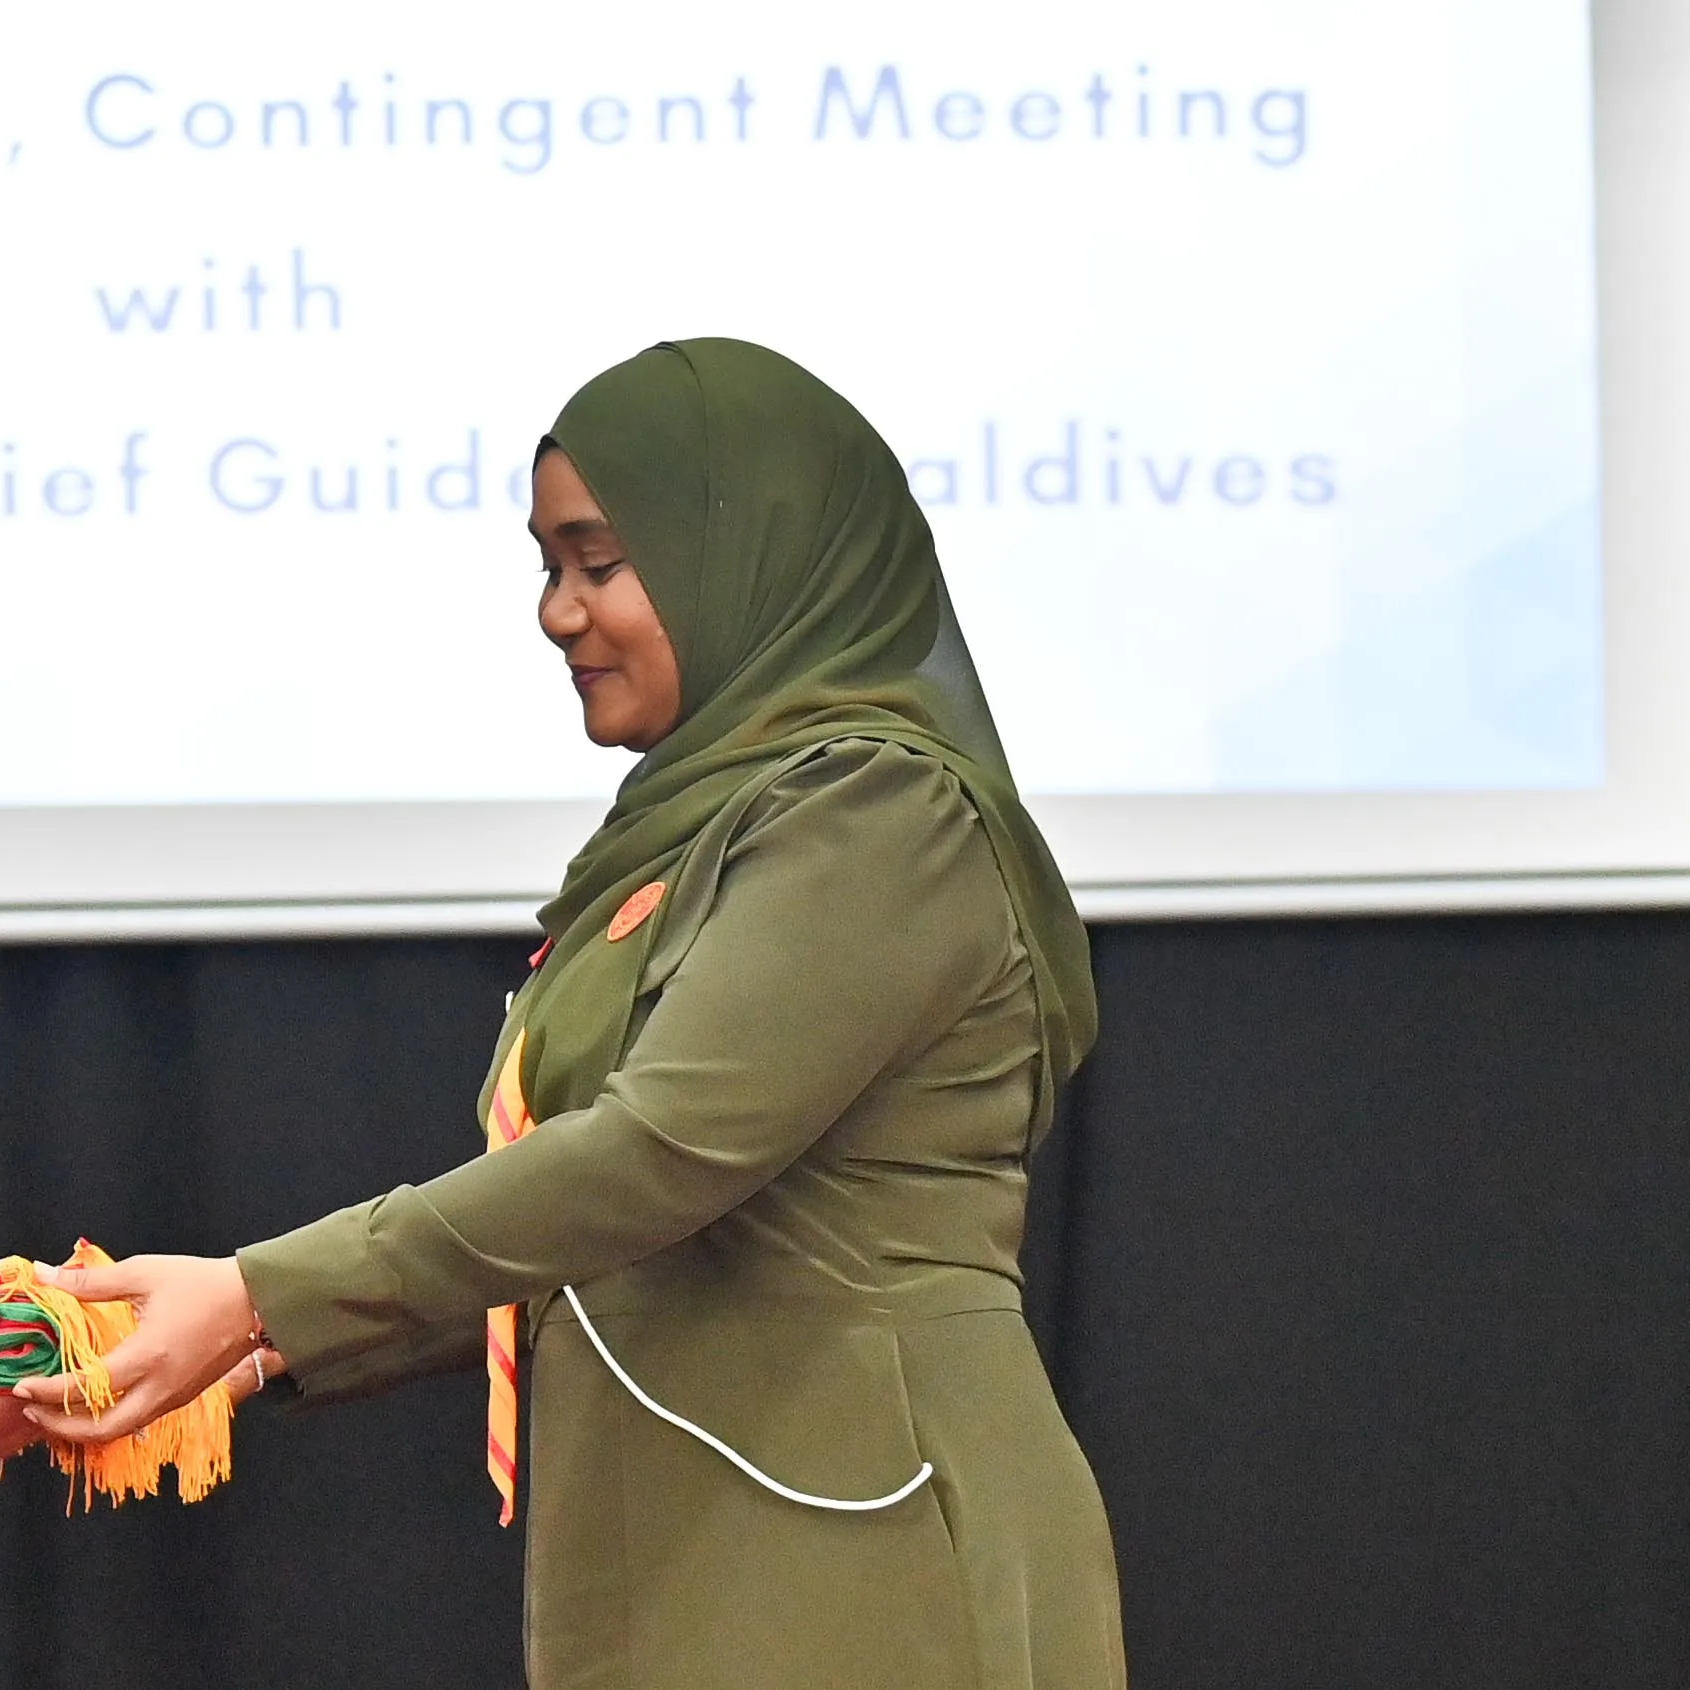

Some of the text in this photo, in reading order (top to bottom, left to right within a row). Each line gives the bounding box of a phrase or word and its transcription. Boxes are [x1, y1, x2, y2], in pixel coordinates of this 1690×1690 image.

[82, 70, 756, 176] Contingent
[811, 60, 1311, 171] Meeting
[92, 246, 342, 335] with
[908, 417, 1342, 509] aldives
